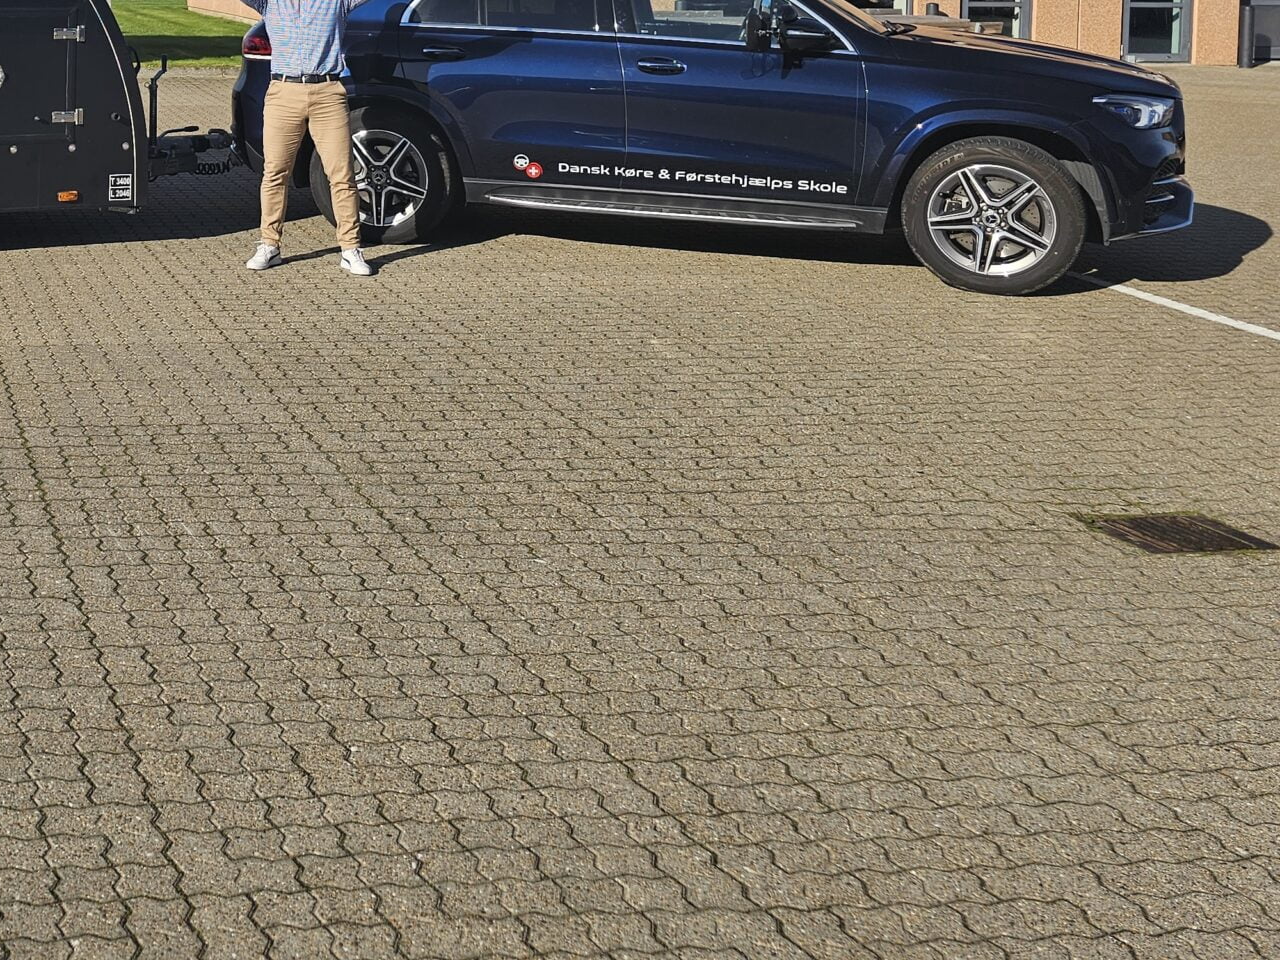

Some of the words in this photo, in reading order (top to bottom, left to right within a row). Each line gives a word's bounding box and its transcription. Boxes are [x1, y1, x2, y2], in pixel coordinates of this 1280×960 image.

[111, 177, 115, 185] T
[559, 163, 609, 175] Dansk
[615, 167, 653, 178] Køre
[658, 169, 670, 179] &
[676, 171, 792, 189] Førstehjælps
[798, 180, 847, 193] Skole
